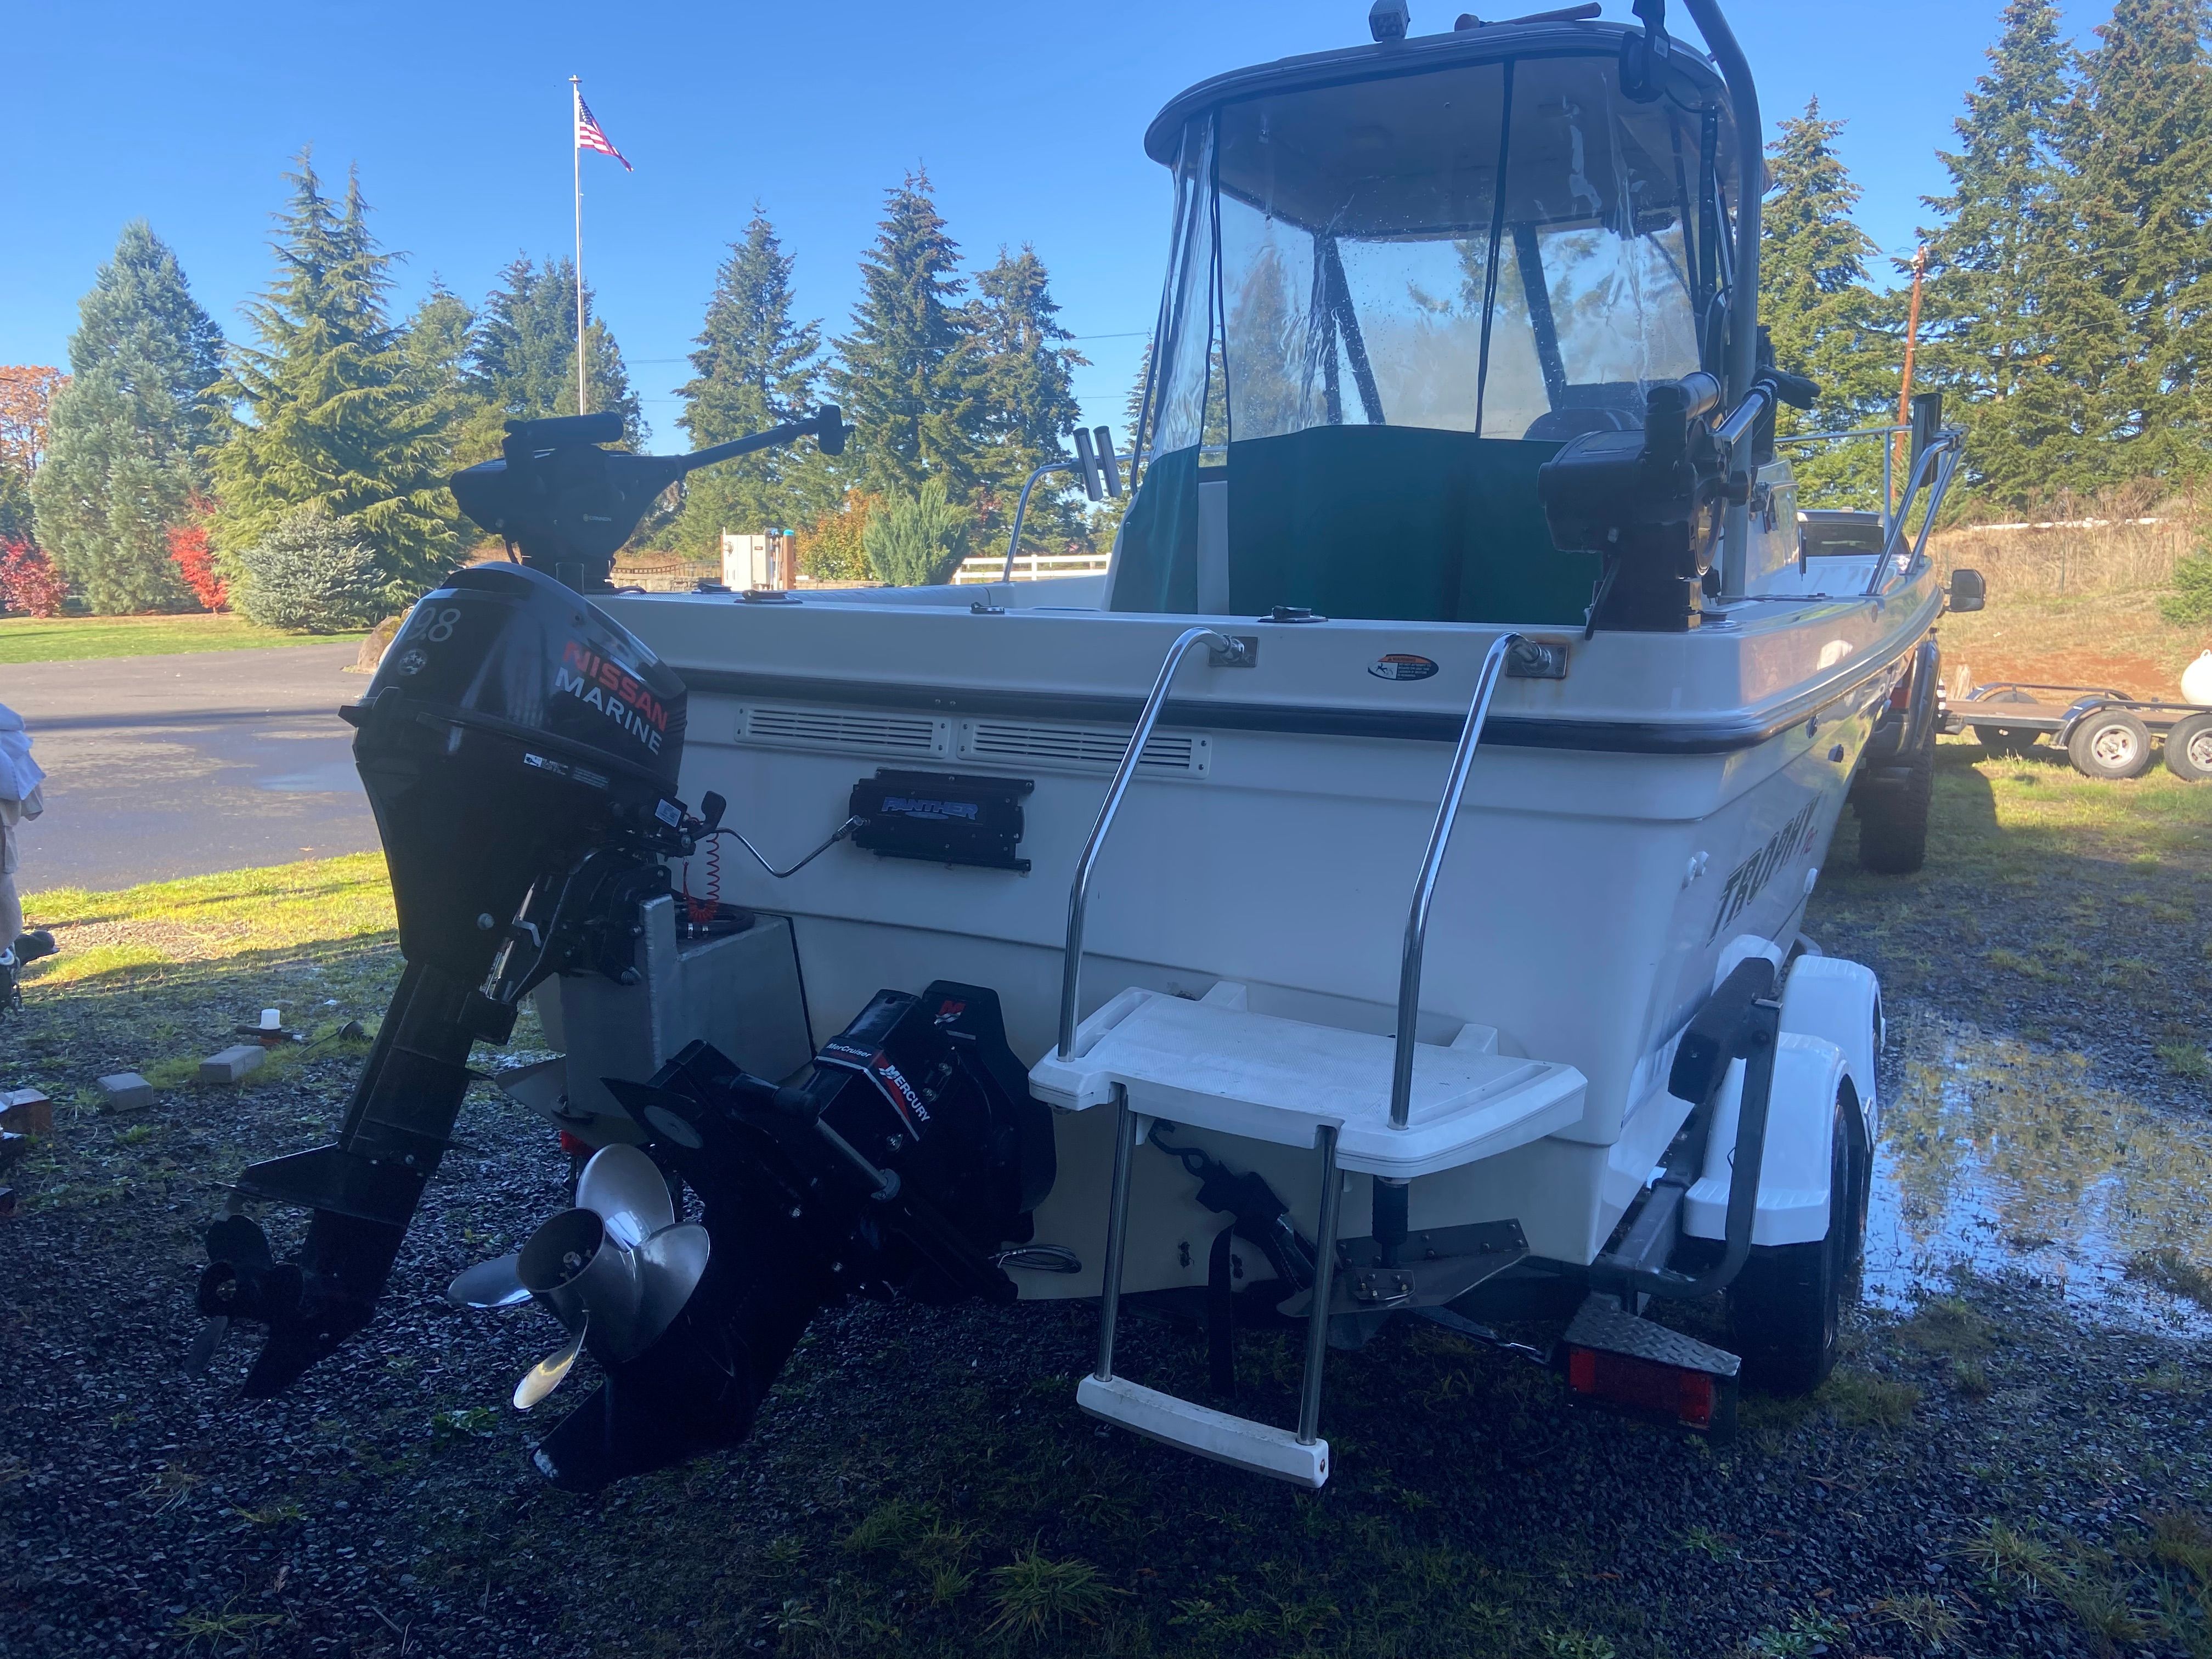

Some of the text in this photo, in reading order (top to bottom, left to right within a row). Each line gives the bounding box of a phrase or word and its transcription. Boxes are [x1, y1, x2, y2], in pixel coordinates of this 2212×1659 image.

[406, 607, 461, 642] 9.8
[555, 667, 663, 755] MARINE
[562, 640, 668, 732] NISSAN
[881, 797, 978, 820] PANTHER
[1706, 791, 1822, 948] TROPHY
[826, 1042, 872, 1058] MerCruiser
[883, 1064, 931, 1122] MERCURY
